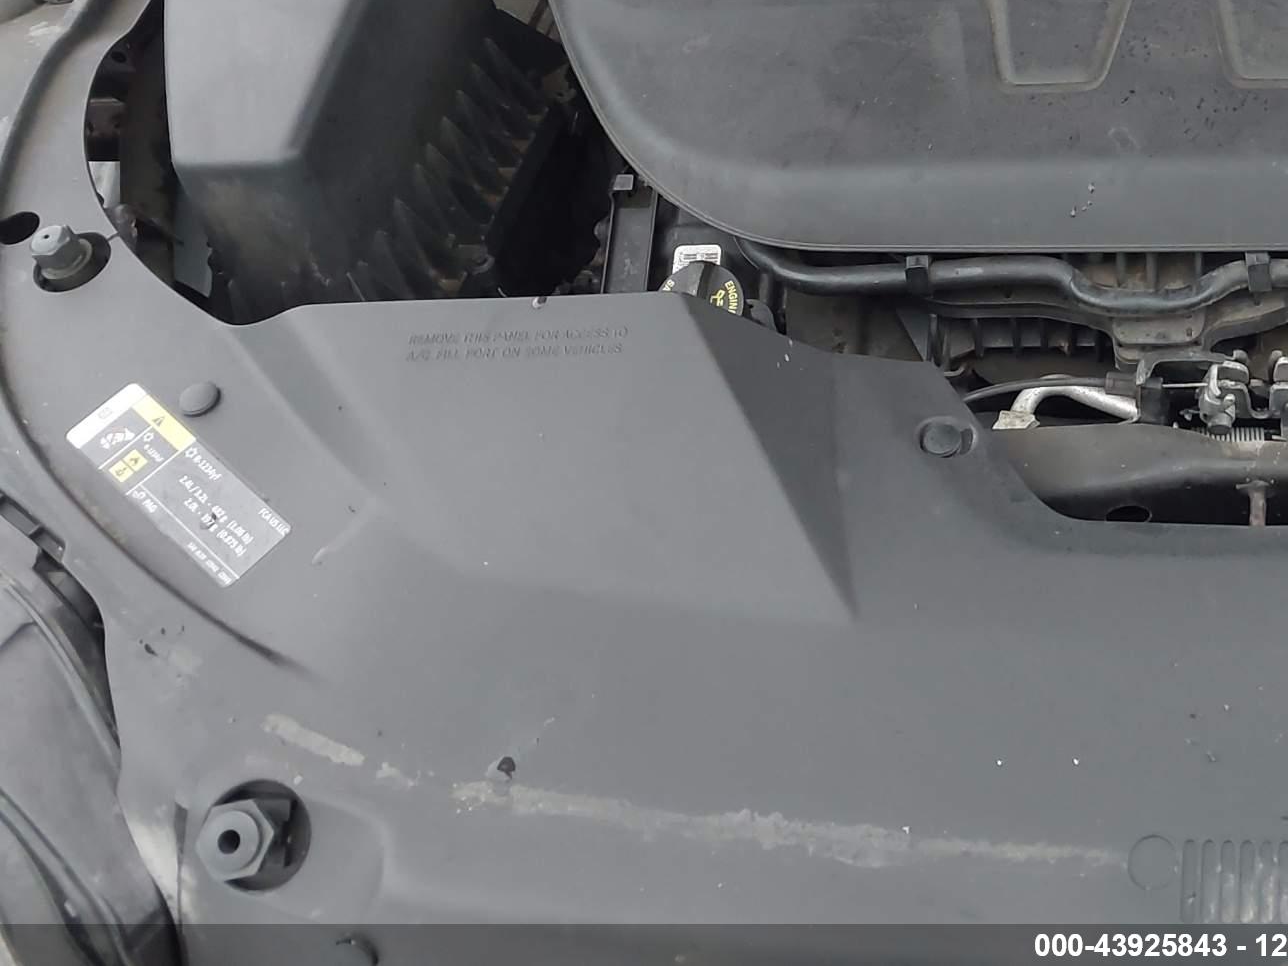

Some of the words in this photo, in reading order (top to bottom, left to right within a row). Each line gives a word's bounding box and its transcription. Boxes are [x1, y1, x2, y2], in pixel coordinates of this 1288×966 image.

[463, 332, 489, 344] THIS
[492, 330, 530, 343] PANEL
[533, 329, 560, 342] FOR
[563, 327, 609, 340] ACCESS
[611, 325, 629, 338] TO
[464, 347, 498, 359] PORT
[501, 346, 521, 358] ON
[562, 342, 623, 356] VEHICLES
